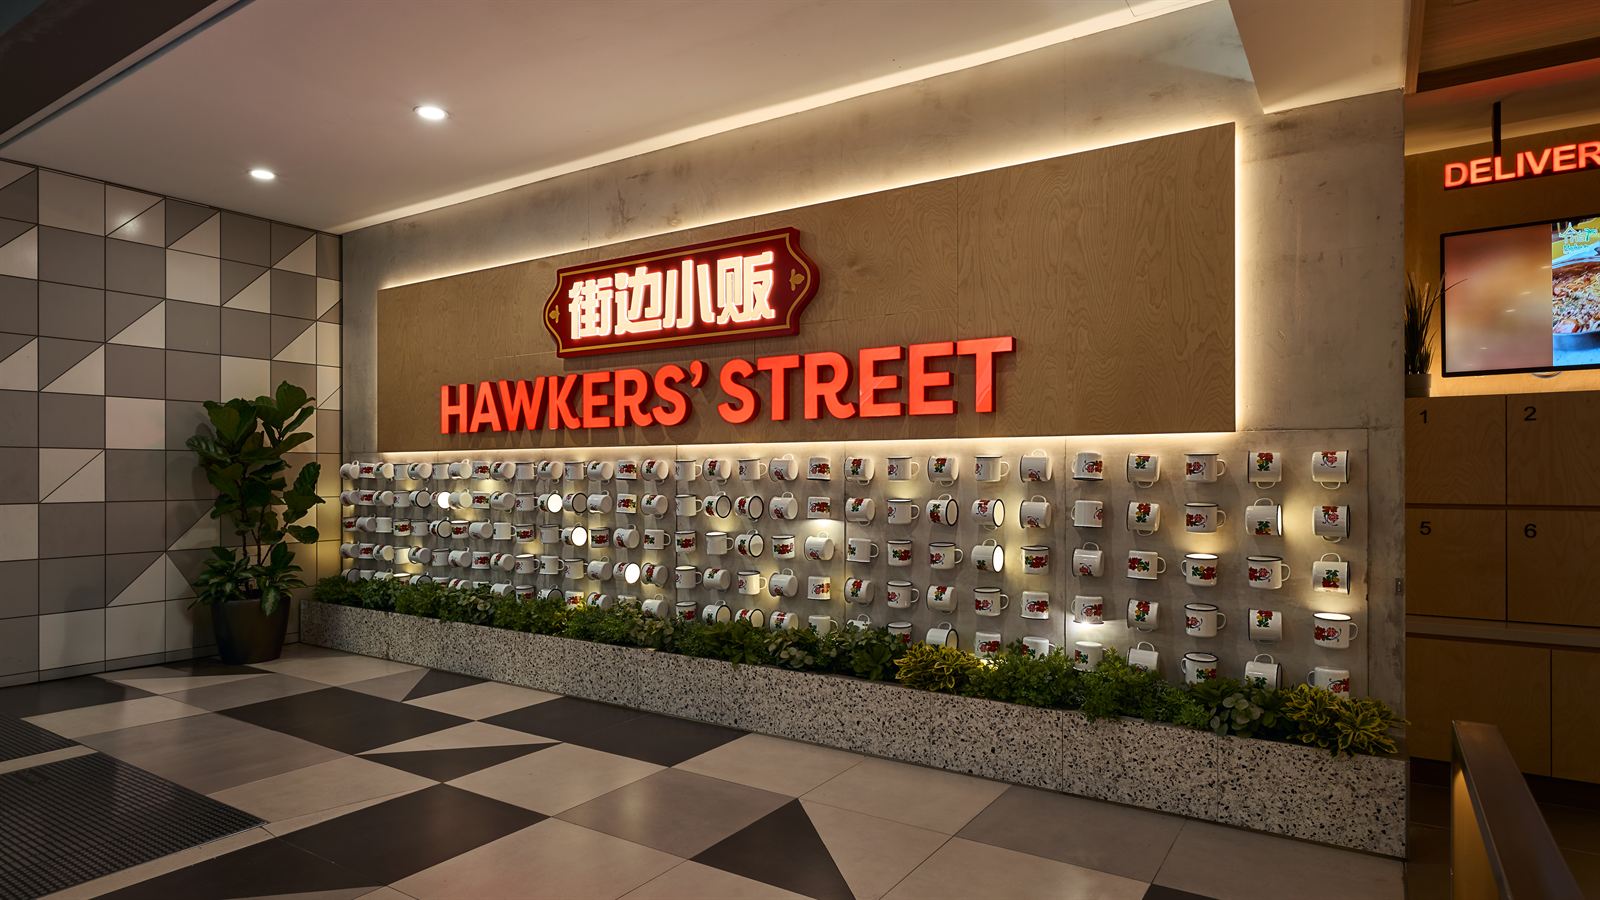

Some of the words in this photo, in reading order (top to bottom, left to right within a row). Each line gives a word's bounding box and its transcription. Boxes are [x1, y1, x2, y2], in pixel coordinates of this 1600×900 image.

[1444, 141, 1600, 188] DELIVER
[568, 251, 776, 340] 街边小贩
[440, 360, 708, 434] HAWKERS’
[718, 336, 1015, 424] STREET
[1418, 410, 1428, 424] 1
[1523, 406, 1537, 421] 2
[1419, 521, 1432, 535] 5
[1523, 523, 1537, 538] 6
